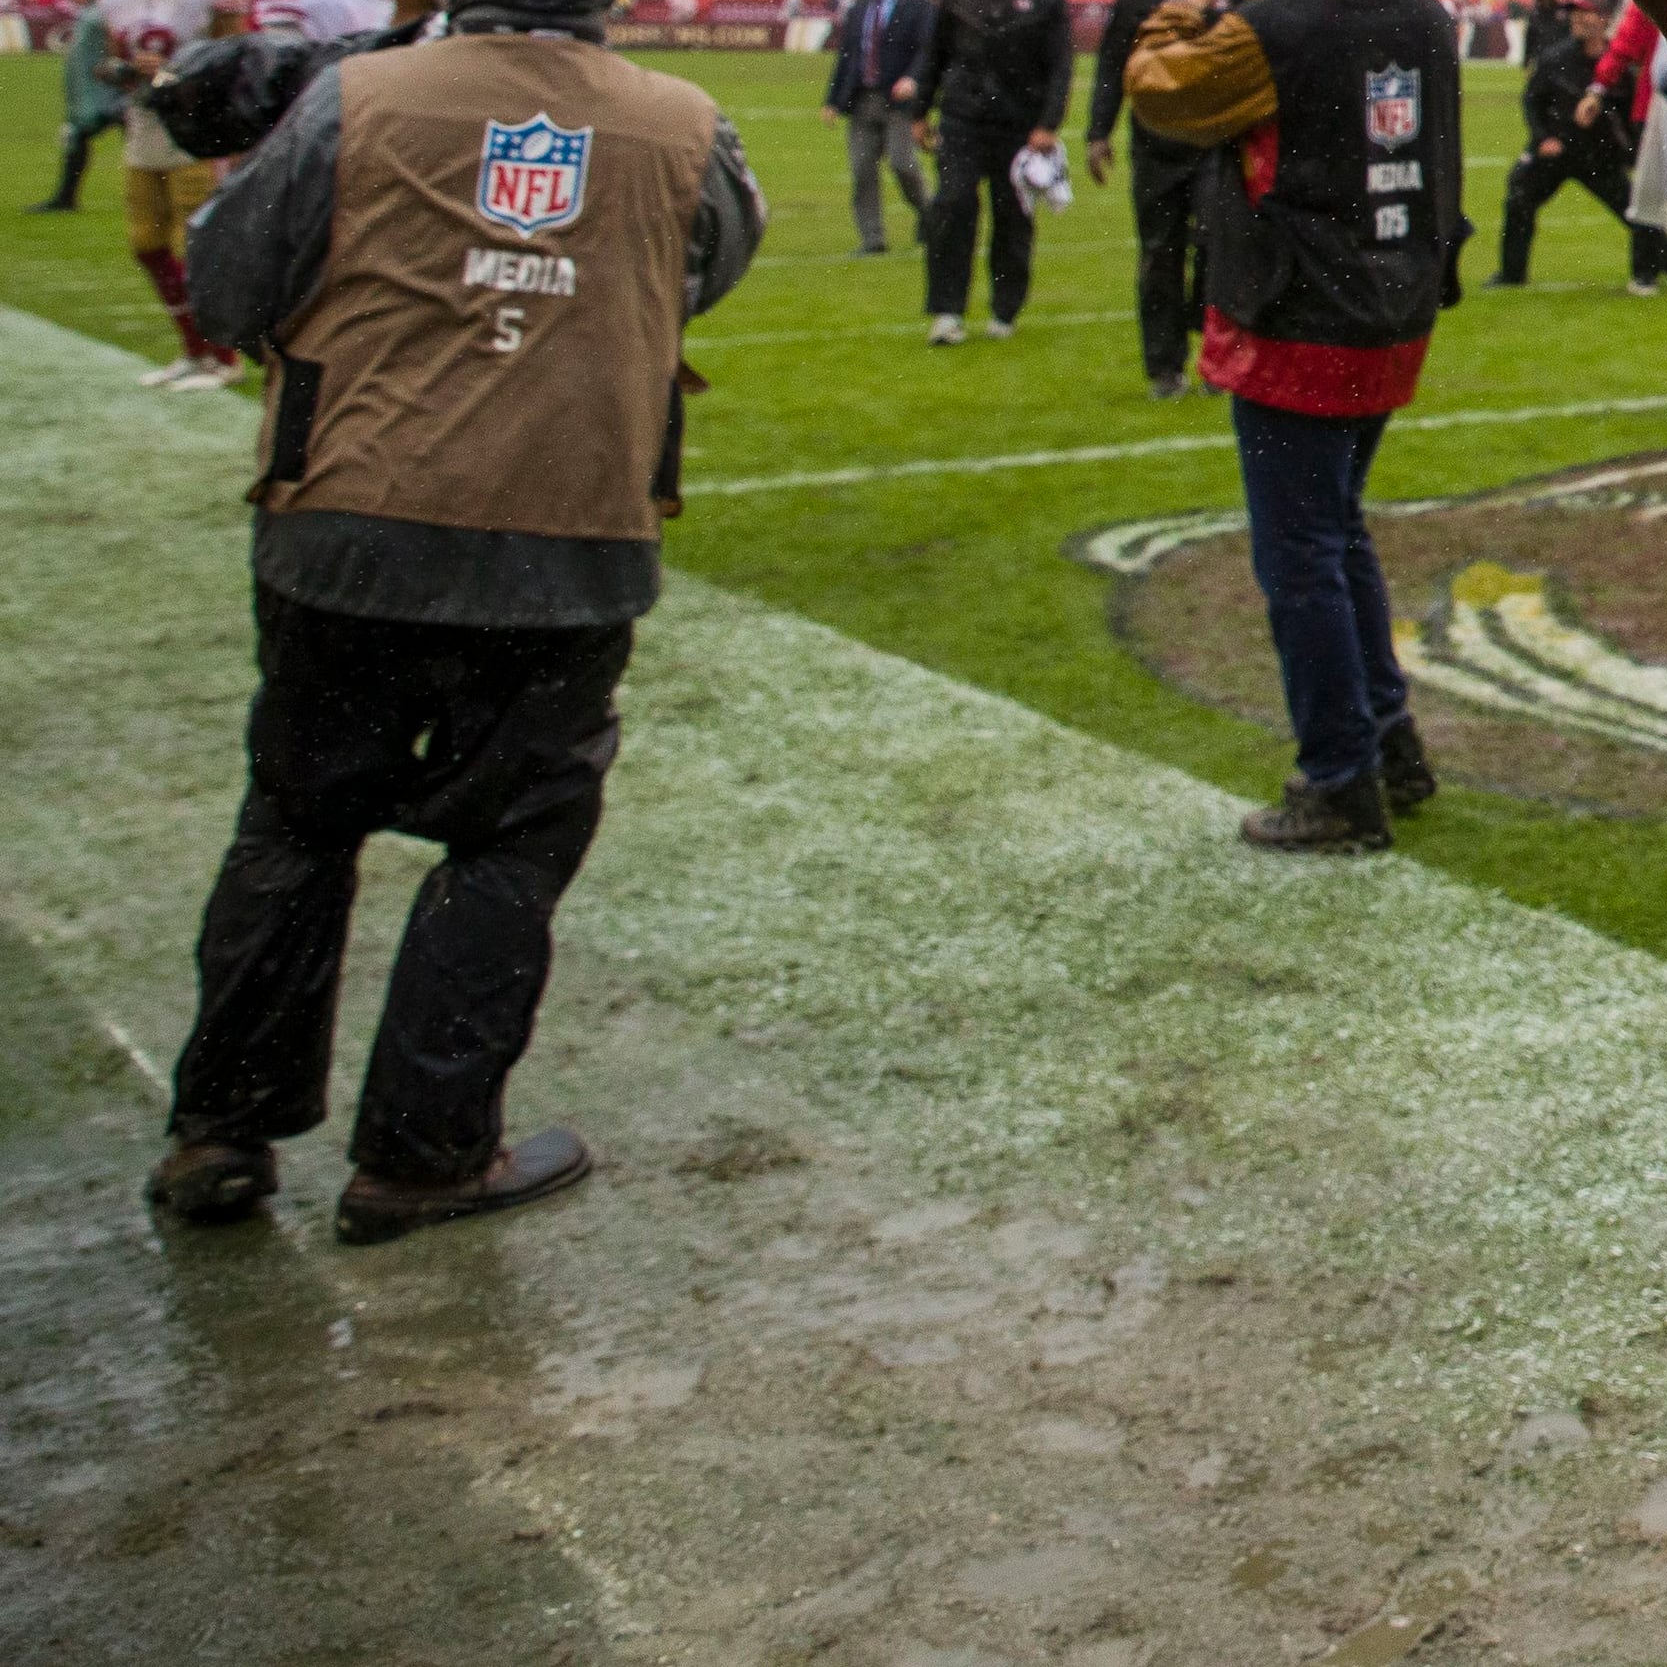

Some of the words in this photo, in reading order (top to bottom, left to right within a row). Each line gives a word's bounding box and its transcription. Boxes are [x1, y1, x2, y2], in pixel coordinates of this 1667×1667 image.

[1375, 99, 1415, 138] NFL
[492, 165, 569, 218] NFL
[1366, 160, 1424, 194] MEDIA
[463, 247, 577, 298] MEDIA
[492, 307, 526, 353] 5
